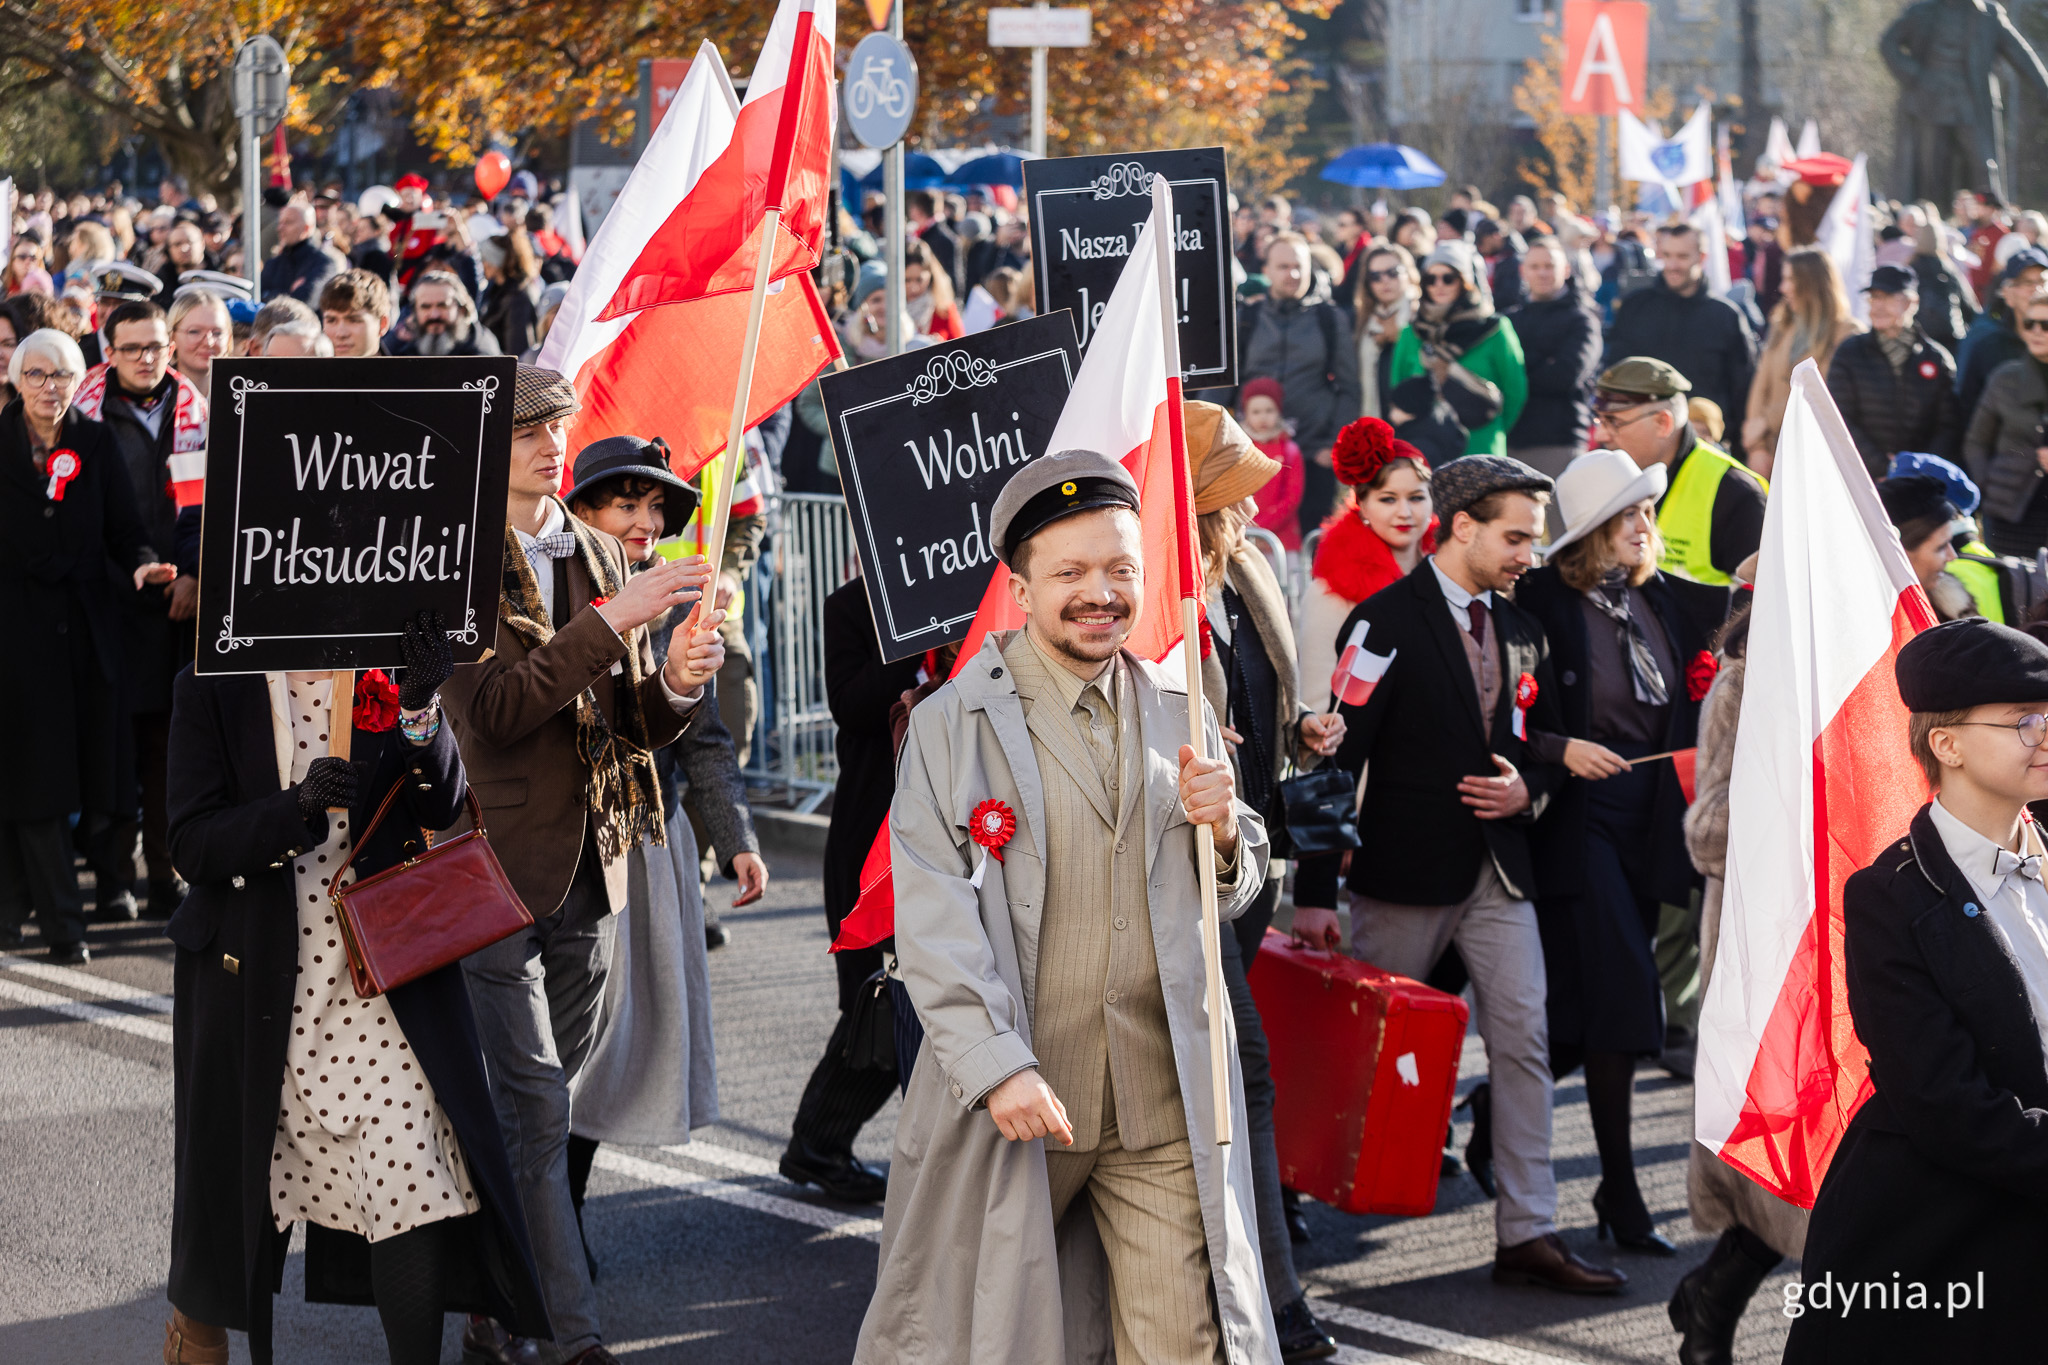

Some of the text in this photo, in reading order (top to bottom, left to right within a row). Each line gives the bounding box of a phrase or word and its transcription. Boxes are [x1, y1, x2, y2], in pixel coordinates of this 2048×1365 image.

[1571, 12, 1633, 104] A
[1059, 227, 1130, 261] Nasza
[284, 432, 436, 491] Wiwat
[904, 412, 1031, 490] Wolni
[241, 515, 466, 585] Piłsudski!
[896, 536, 916, 587] i
